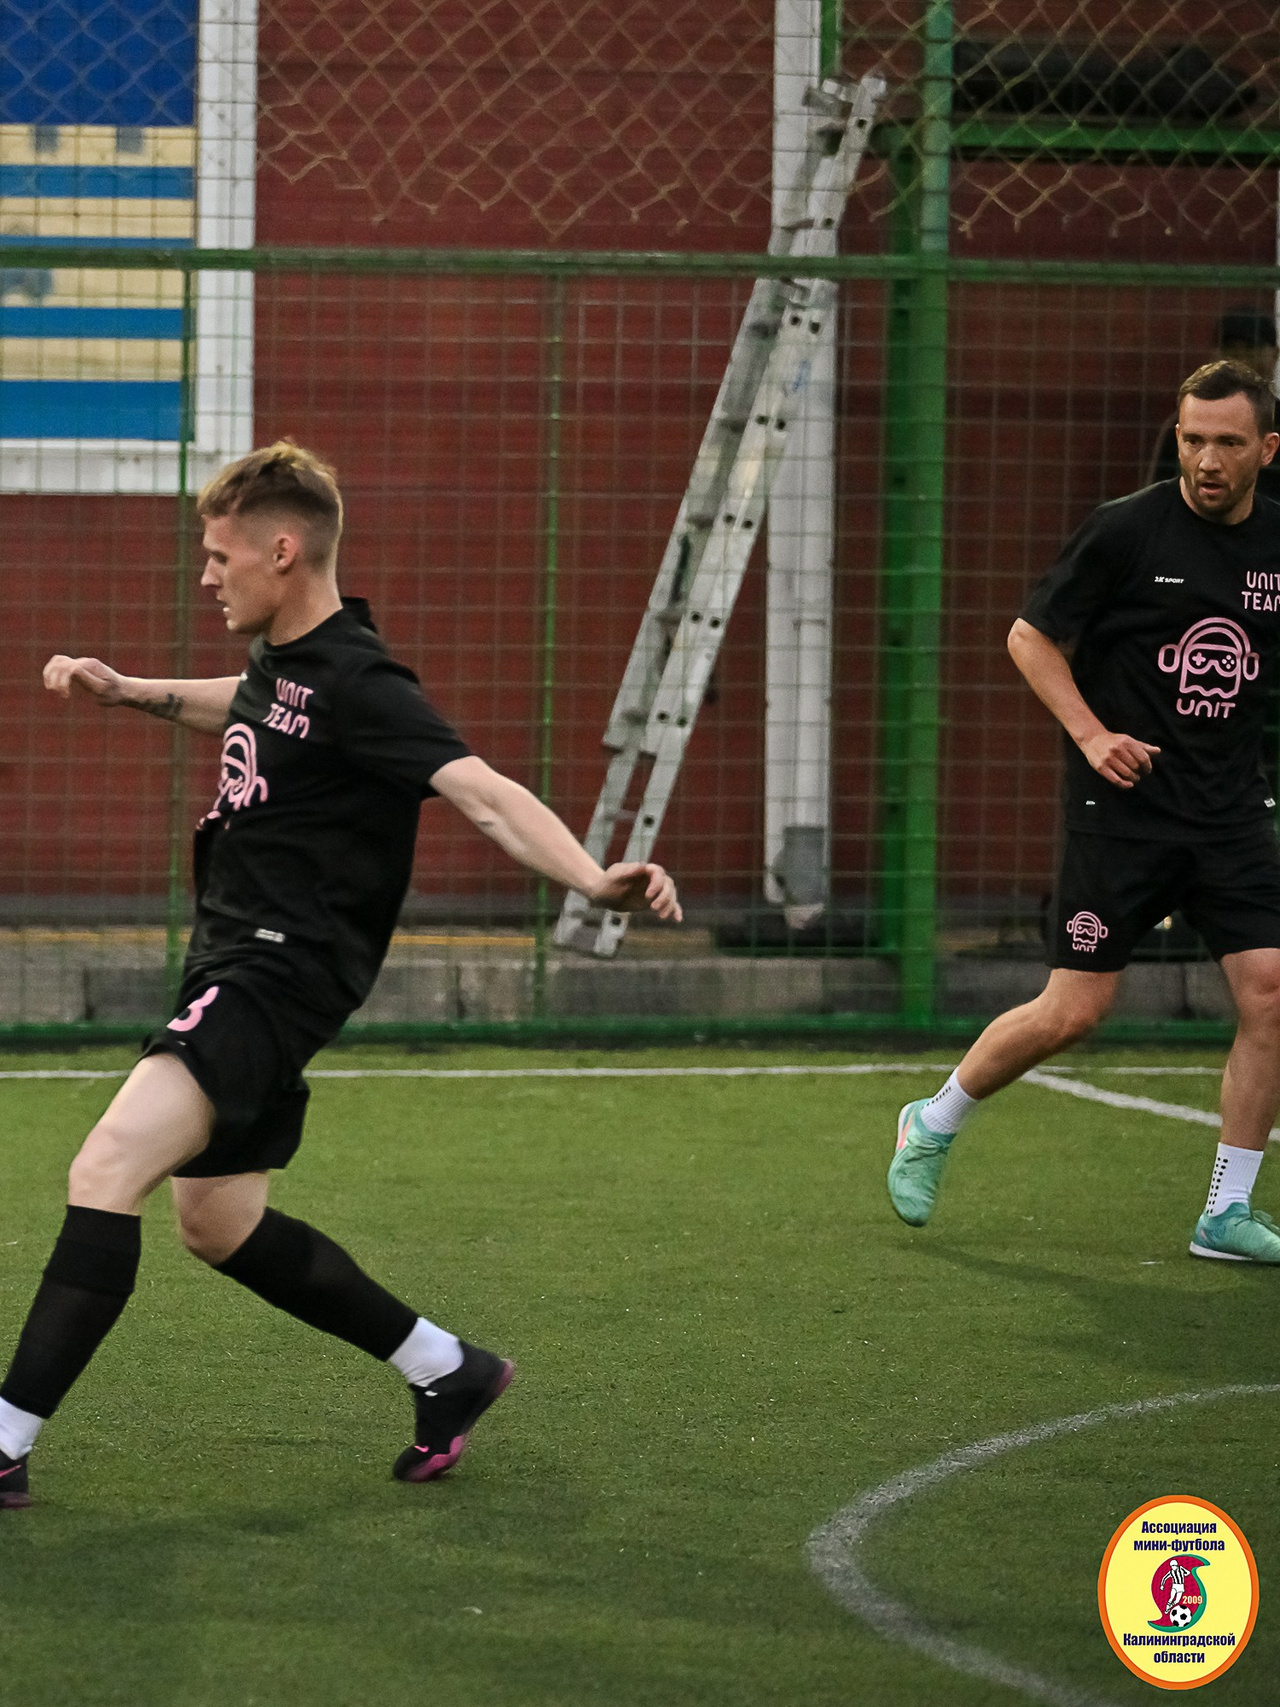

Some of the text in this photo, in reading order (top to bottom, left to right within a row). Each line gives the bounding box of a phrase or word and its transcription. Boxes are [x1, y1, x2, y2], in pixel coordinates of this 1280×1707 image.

[276, 677, 314, 710] UNIT
[261, 703, 310, 739] TEAM
[1176, 698, 1236, 719] UNIT
[1072, 942, 1097, 953] UNIT
